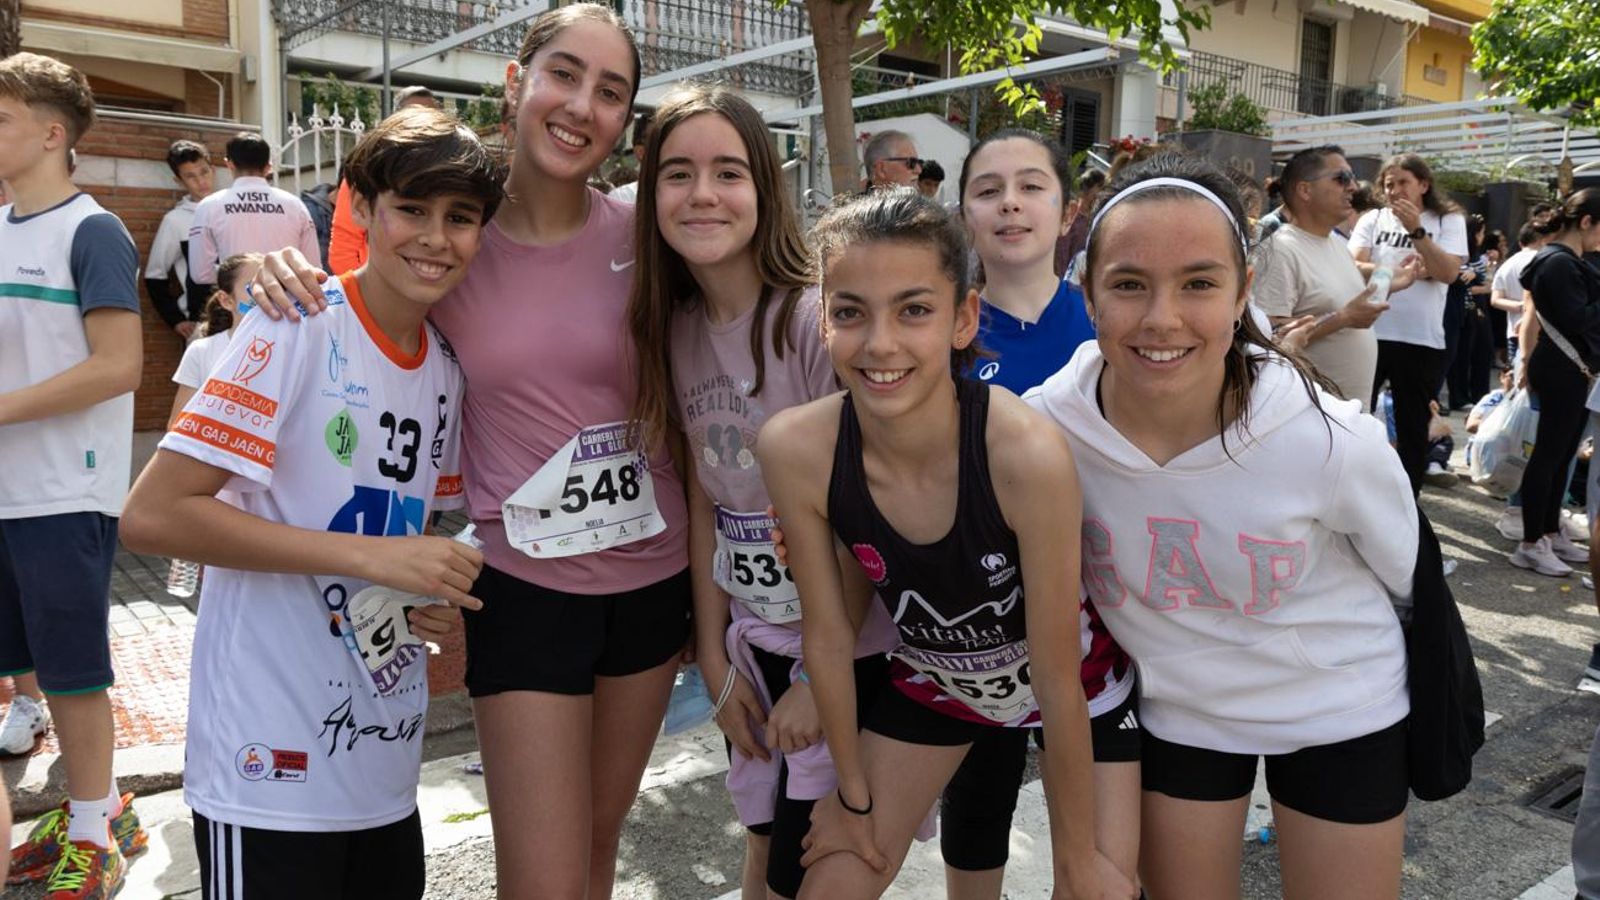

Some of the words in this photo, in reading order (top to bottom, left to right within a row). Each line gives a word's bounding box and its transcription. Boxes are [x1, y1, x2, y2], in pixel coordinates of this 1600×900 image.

[237, 192, 269, 201] VISIT
[224, 203, 284, 214] RWANDA
[205, 381, 274, 416] ACADEMIA
[201, 425, 230, 444] GAB
[230, 437, 265, 458] JAÉN
[581, 431, 615, 446] CARRERA
[590, 443, 603, 455] LA
[540, 465, 641, 519] 548
[751, 530, 763, 540] LA
[983, 660, 997, 670] LA
